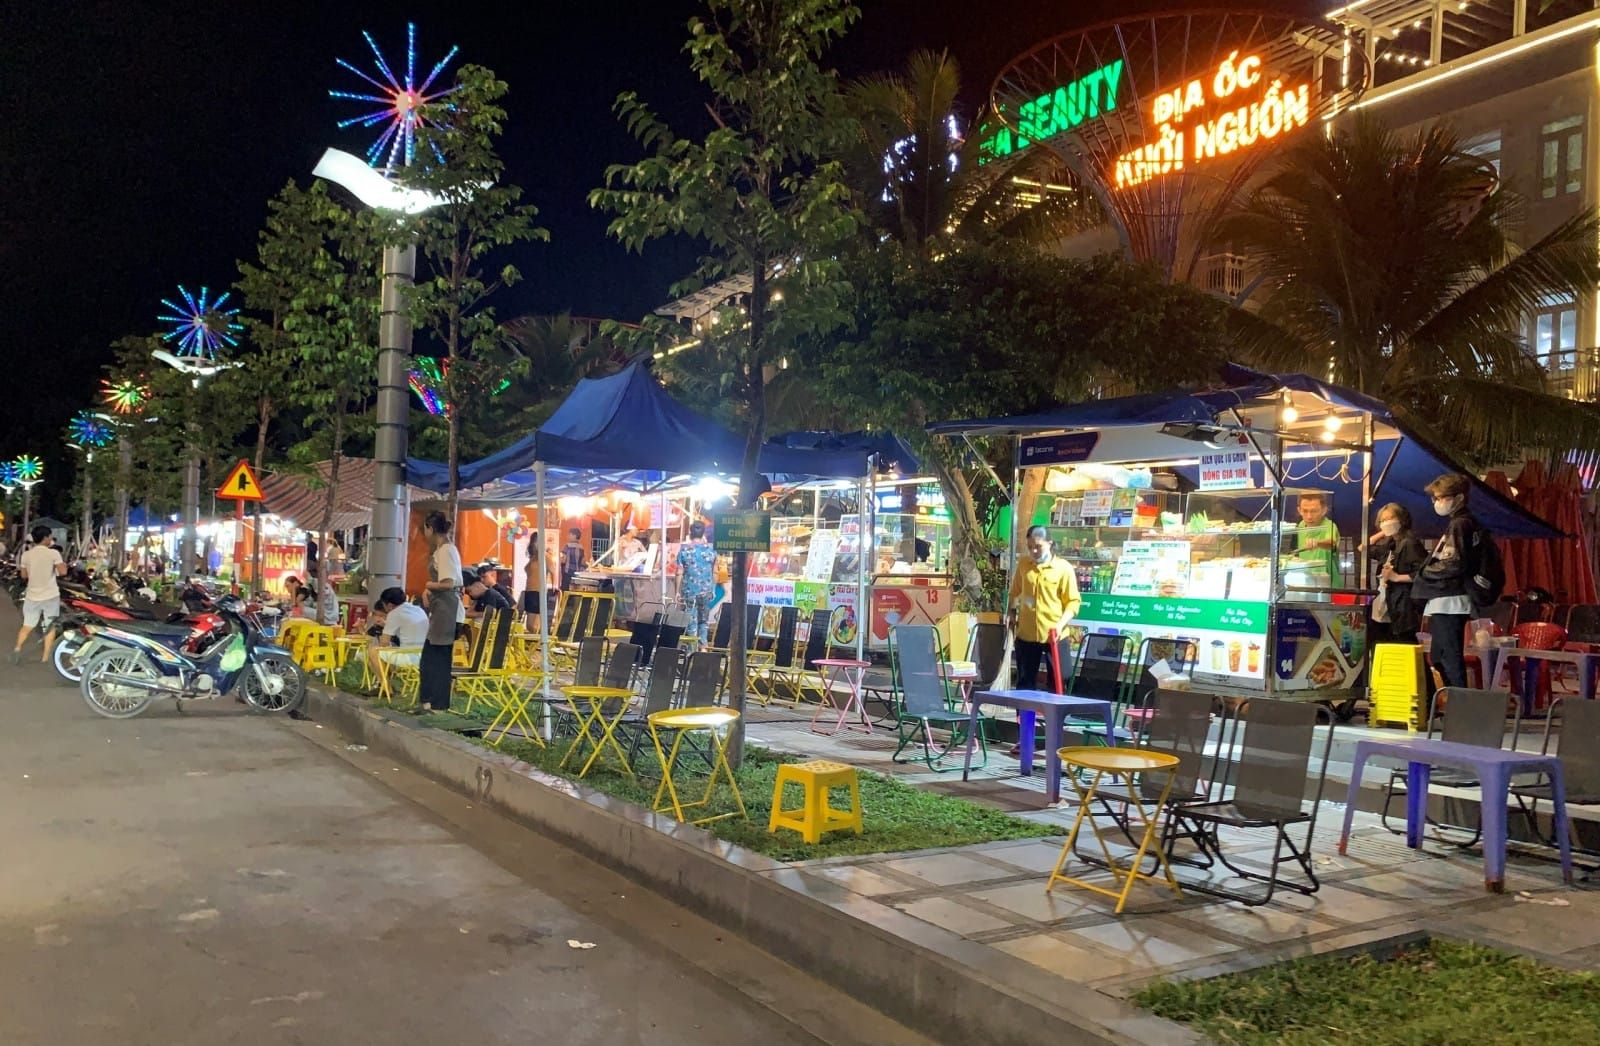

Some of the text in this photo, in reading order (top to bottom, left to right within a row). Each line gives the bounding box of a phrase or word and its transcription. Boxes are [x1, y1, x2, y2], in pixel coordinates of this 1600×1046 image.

[1017, 59, 1124, 149] BEAUTY
[1153, 50, 1261, 125] ĐỊA ỐC
[1195, 80, 1309, 163] NGUỒN
[927, 590, 938, 604] 13
